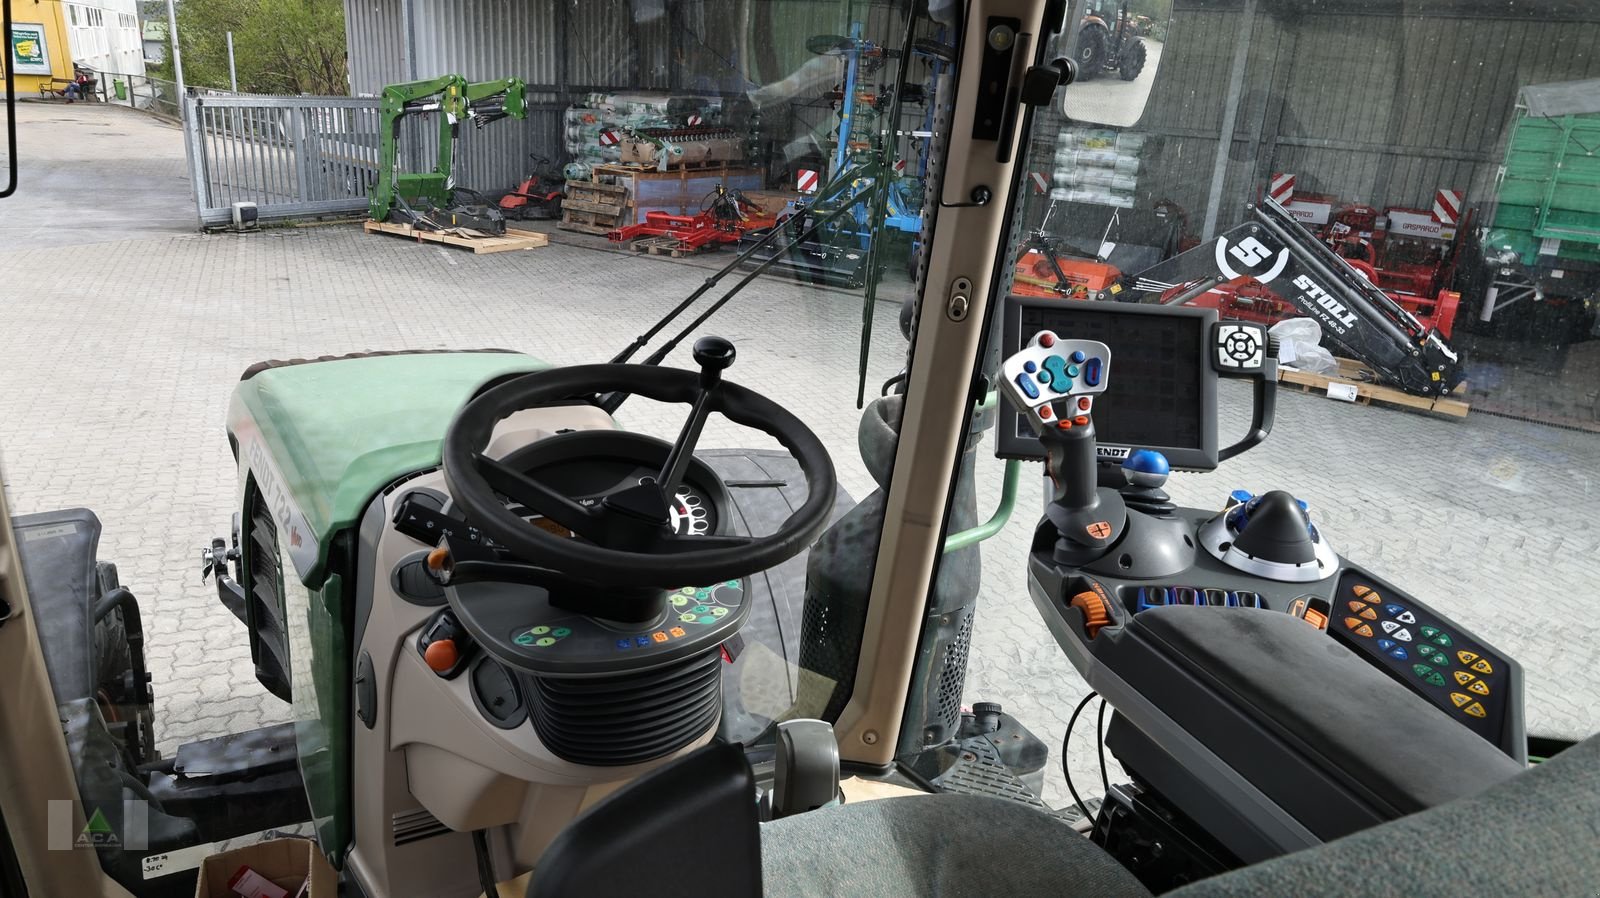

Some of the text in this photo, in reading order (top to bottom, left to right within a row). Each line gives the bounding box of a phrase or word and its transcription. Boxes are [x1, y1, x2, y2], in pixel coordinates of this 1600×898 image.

[1288, 209, 1313, 218] SPARDO
[1402, 222, 1440, 234] GASPARDO
[1292, 274, 1358, 328] STOLL
[1096, 447, 1128, 457] ENDT
[272, 483, 292, 535] 722
